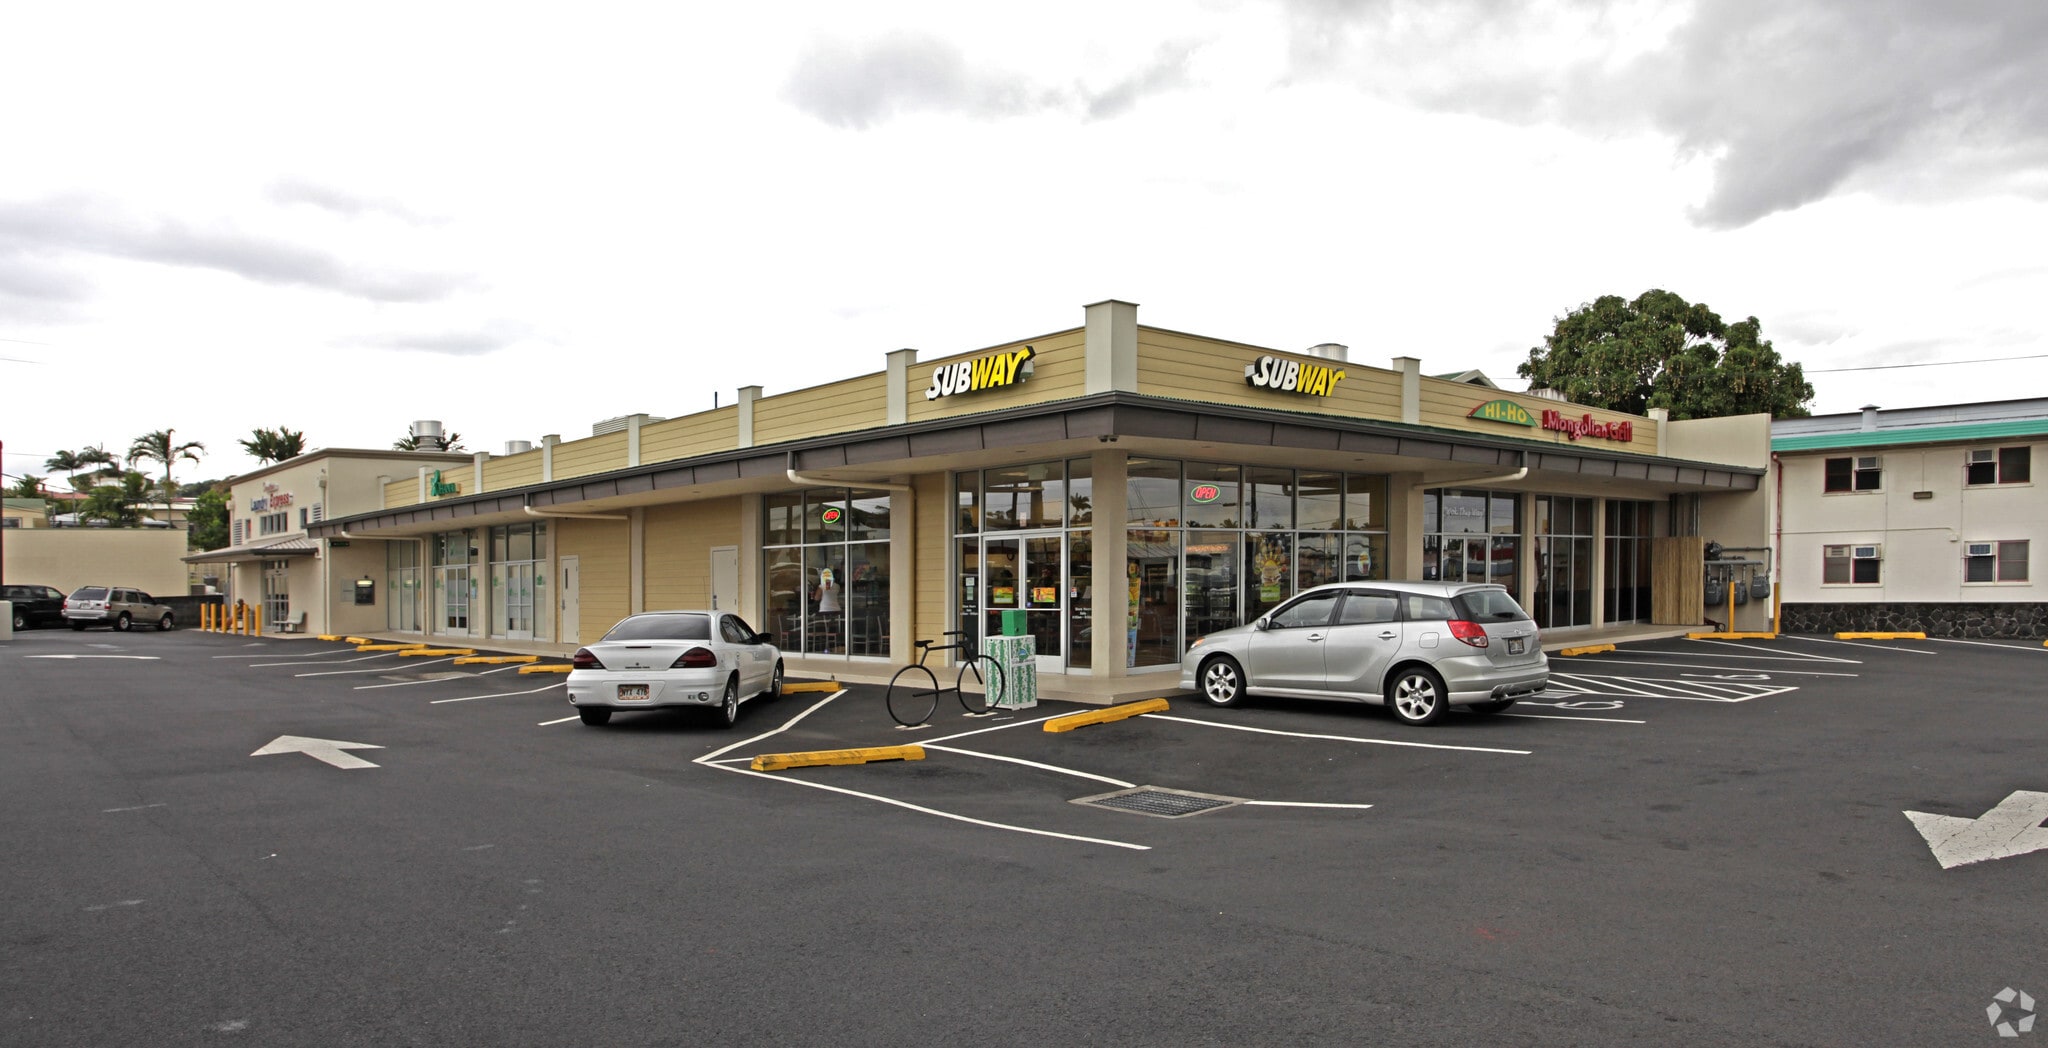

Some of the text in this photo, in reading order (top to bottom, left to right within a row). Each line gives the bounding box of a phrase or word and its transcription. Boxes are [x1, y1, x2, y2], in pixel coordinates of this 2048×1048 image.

[925, 346, 1034, 400] SUBWAY
[1250, 355, 1346, 397] SUBWAY
[1485, 404, 1527, 423] HI-HO
[1543, 409, 1633, 442] Mongolian Grill
[270, 492, 290, 509] Express
[1195, 486, 1217, 499] OPEN
[824, 510, 839, 520] OPEN
